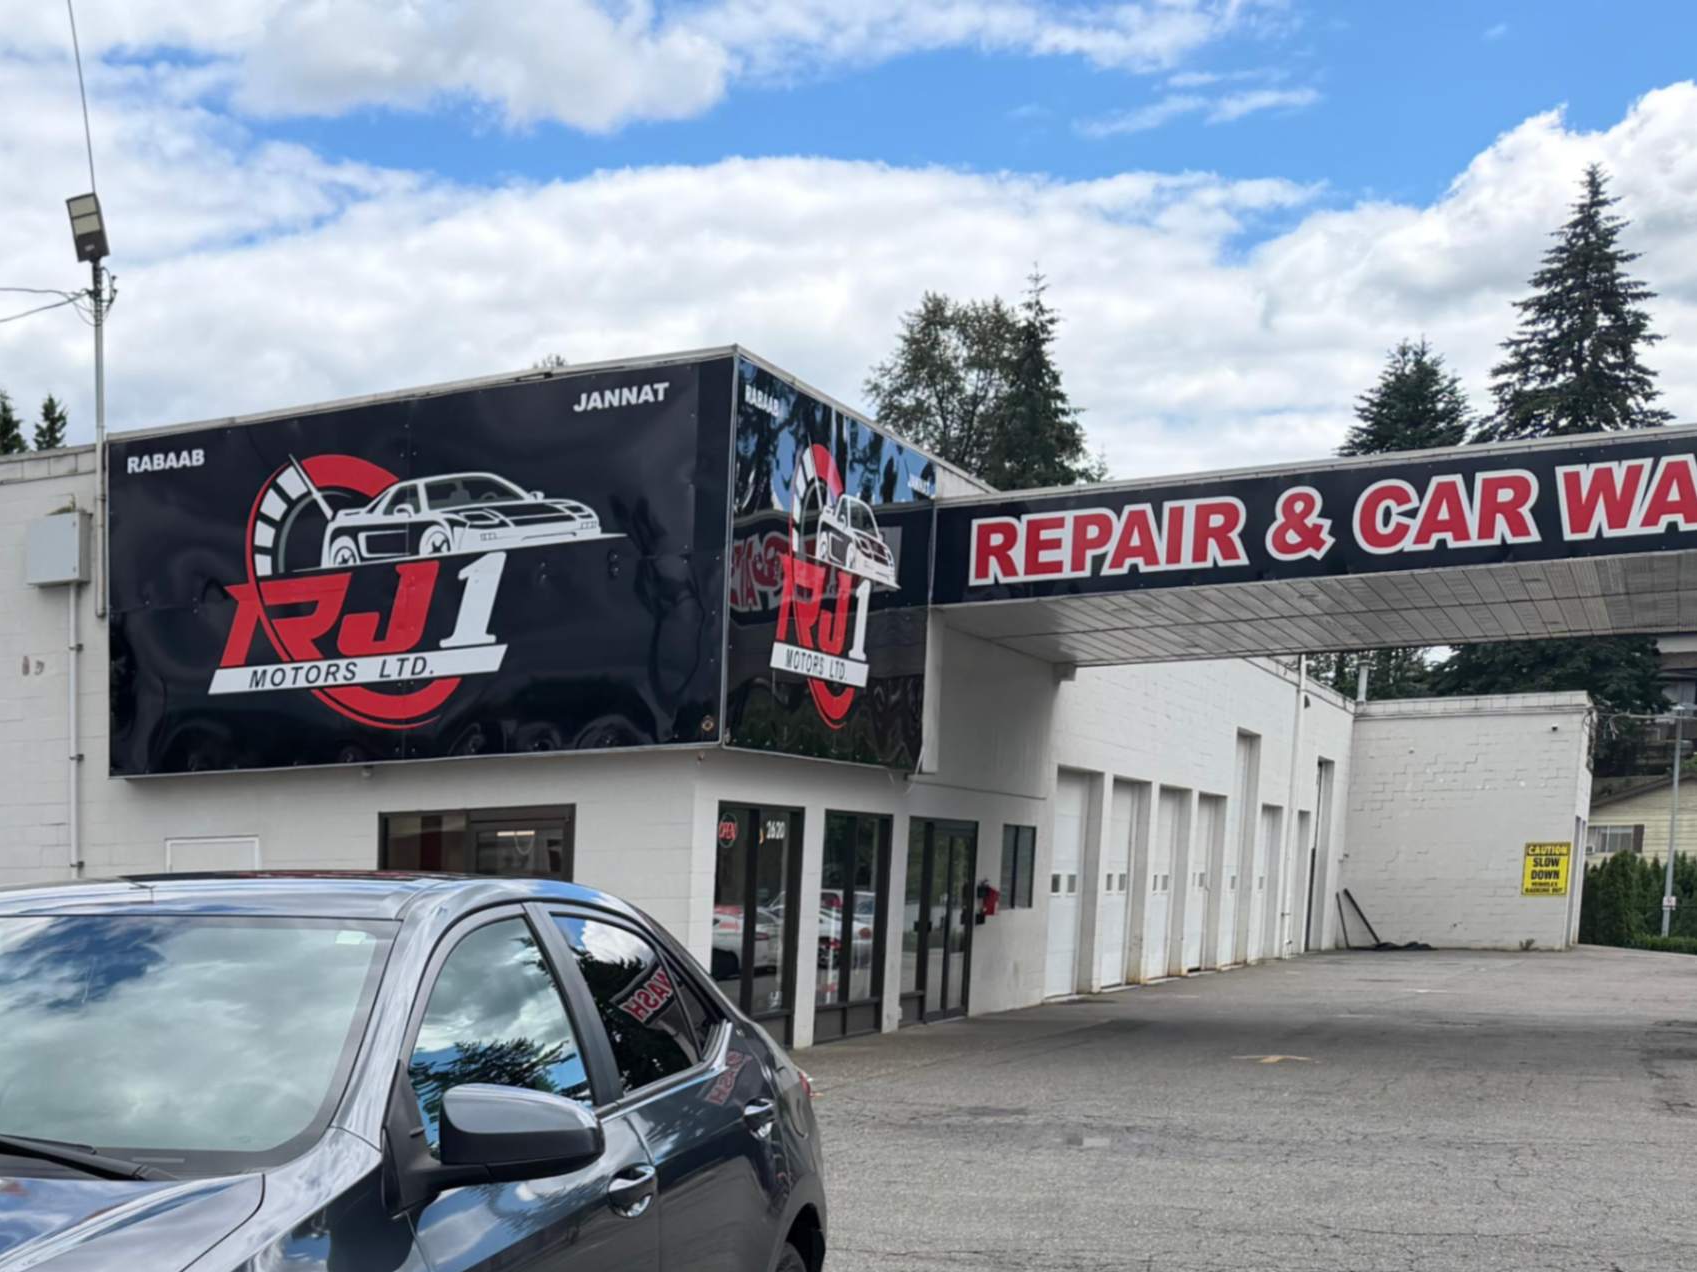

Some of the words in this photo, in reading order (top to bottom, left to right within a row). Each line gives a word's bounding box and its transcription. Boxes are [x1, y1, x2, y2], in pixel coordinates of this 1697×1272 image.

[573, 382, 669, 412] JANNAT
[127, 449, 205, 474] RABAAB
[968, 497, 1249, 586] REPAIR
[1265, 486, 1335, 561] &
[1351, 468, 1542, 555] CAR
[220, 551, 507, 667] RJ1
[249, 661, 358, 689] MOTORS
[379, 656, 434, 678] LTD.
[785, 648, 824, 675] MOTORS
[1531, 869, 1560, 880] DOWN
[1532, 857, 1560, 868] SLOW
